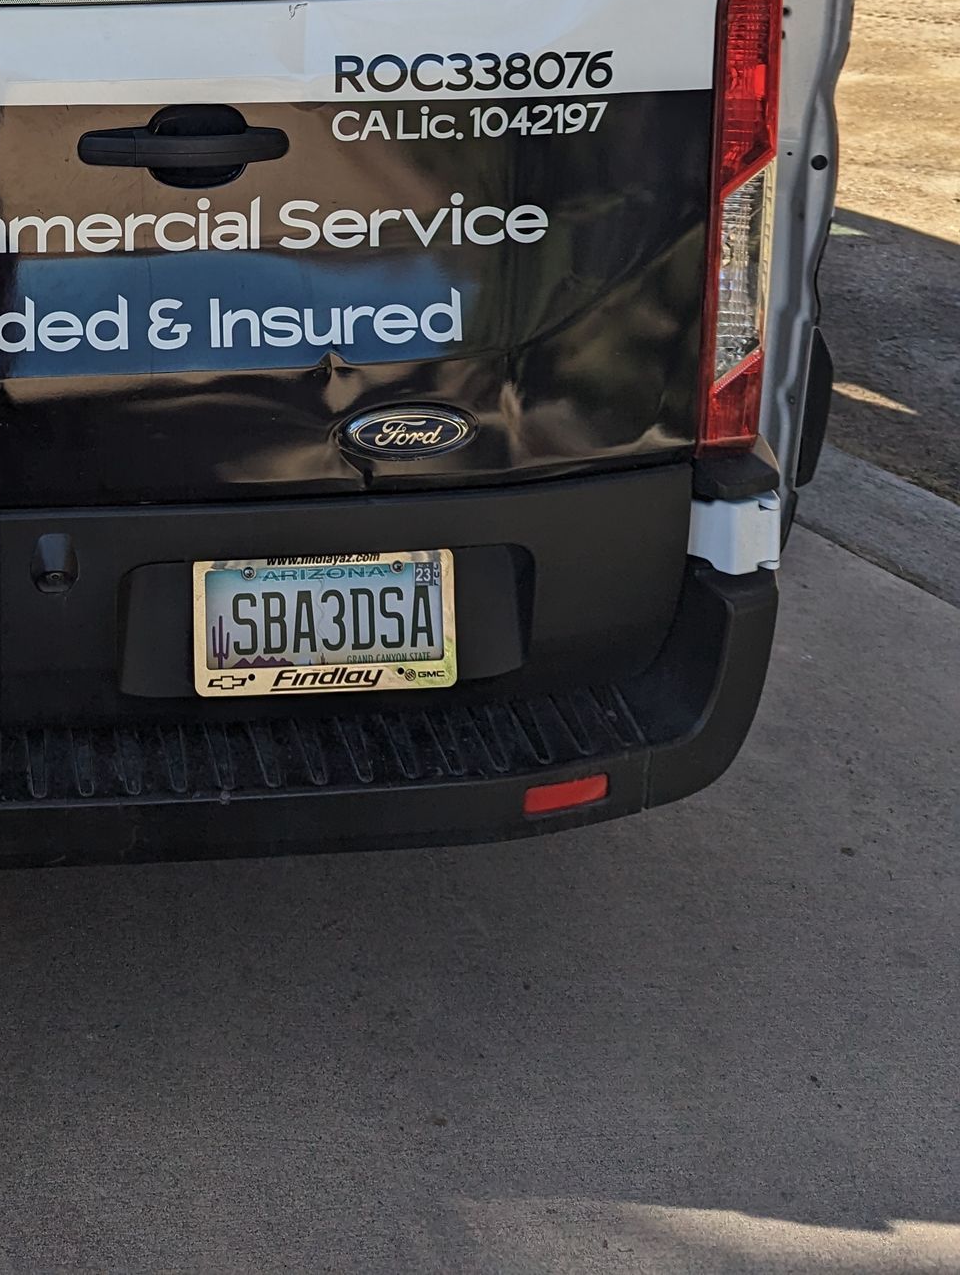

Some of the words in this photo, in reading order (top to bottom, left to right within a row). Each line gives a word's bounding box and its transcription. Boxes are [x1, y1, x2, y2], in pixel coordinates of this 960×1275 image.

[334, 50, 614, 93] ROC338076
[331, 109, 391, 142] CA
[396, 105, 464, 140] Lic.
[469, 101, 609, 138] 1042197
[278, 193, 549, 250] Service
[147, 298, 191, 350] &
[210, 287, 463, 348] Insured
[374, 420, 443, 446] Ford
[262, 566, 385, 581] ARIZONA
[415, 568, 431, 582] 23
[232, 586, 435, 656] SBA3DSA
[347, 654, 373, 664] GRAND
[376, 652, 408, 662] CANYON
[409, 651, 431, 661] STATE
[272, 667, 384, 687] Findlay
[417, 670, 445, 678] GMC
